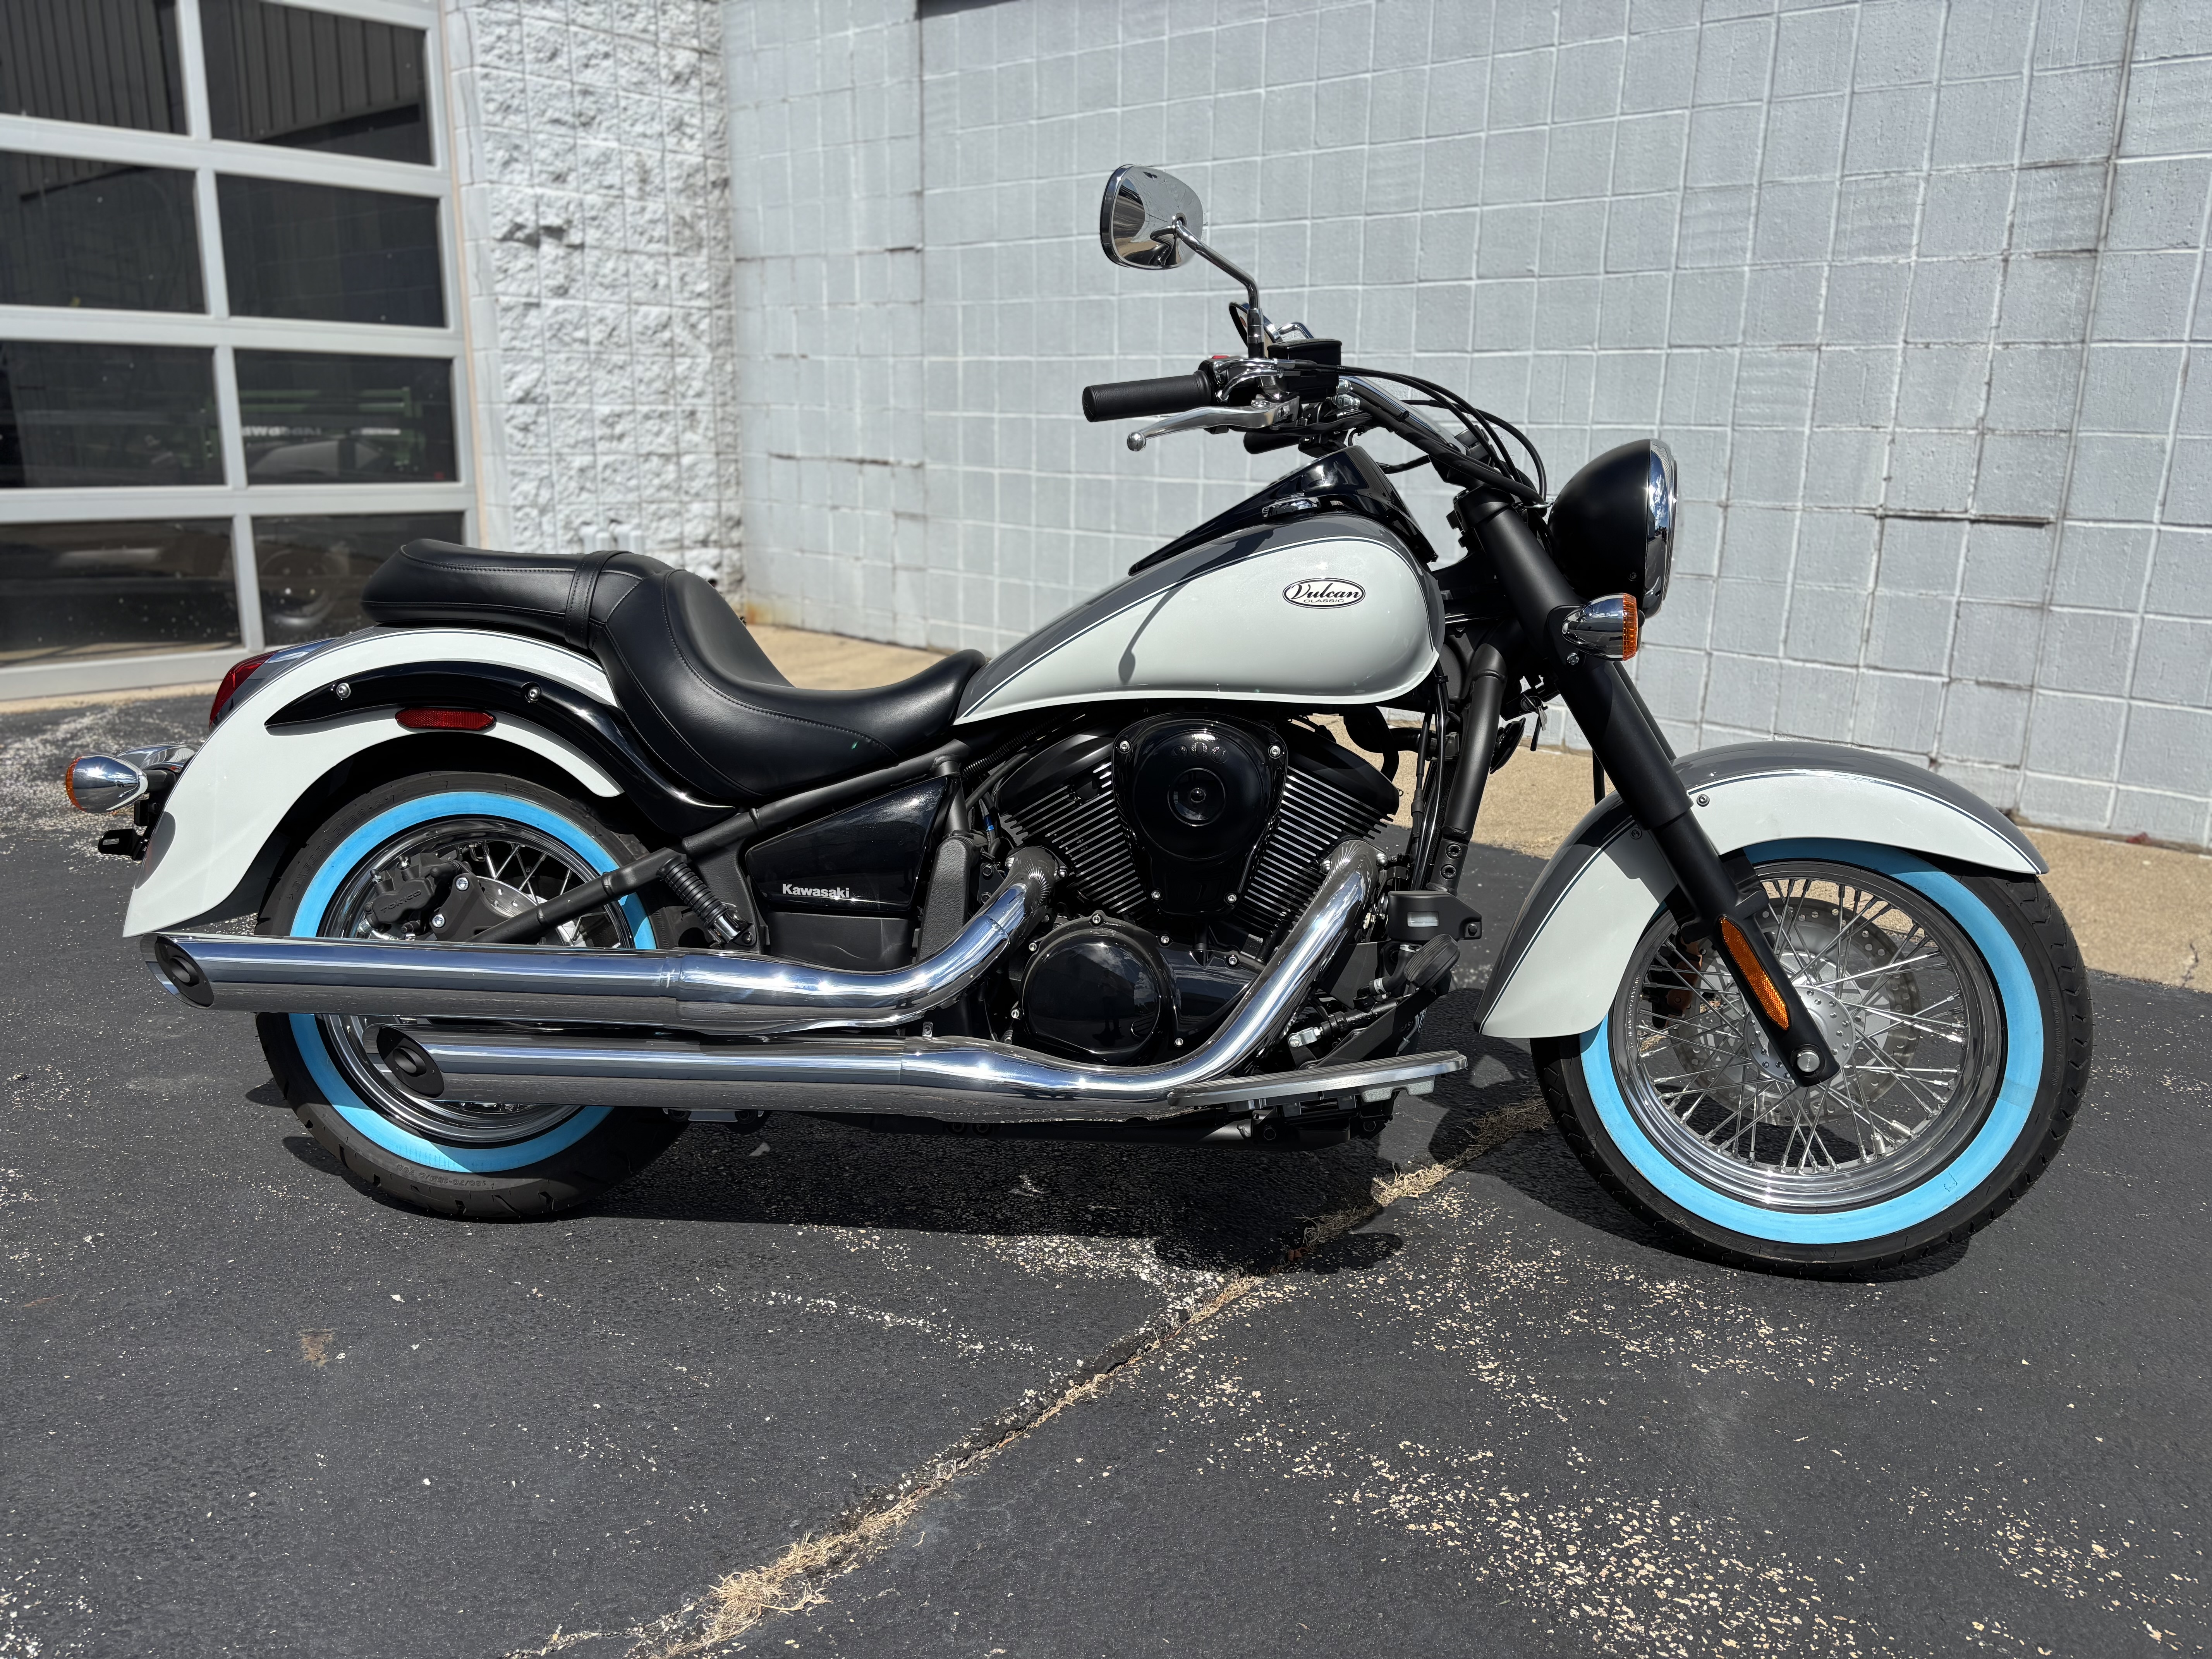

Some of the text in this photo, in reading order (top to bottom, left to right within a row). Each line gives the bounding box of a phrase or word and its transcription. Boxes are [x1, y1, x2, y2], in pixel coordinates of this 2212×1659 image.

[1290, 582, 1361, 599] Vulcan
[1171, 742, 1228, 764] 900
[782, 883, 850, 898] Kawasaki
[380, 890, 421, 913] TOKICO
